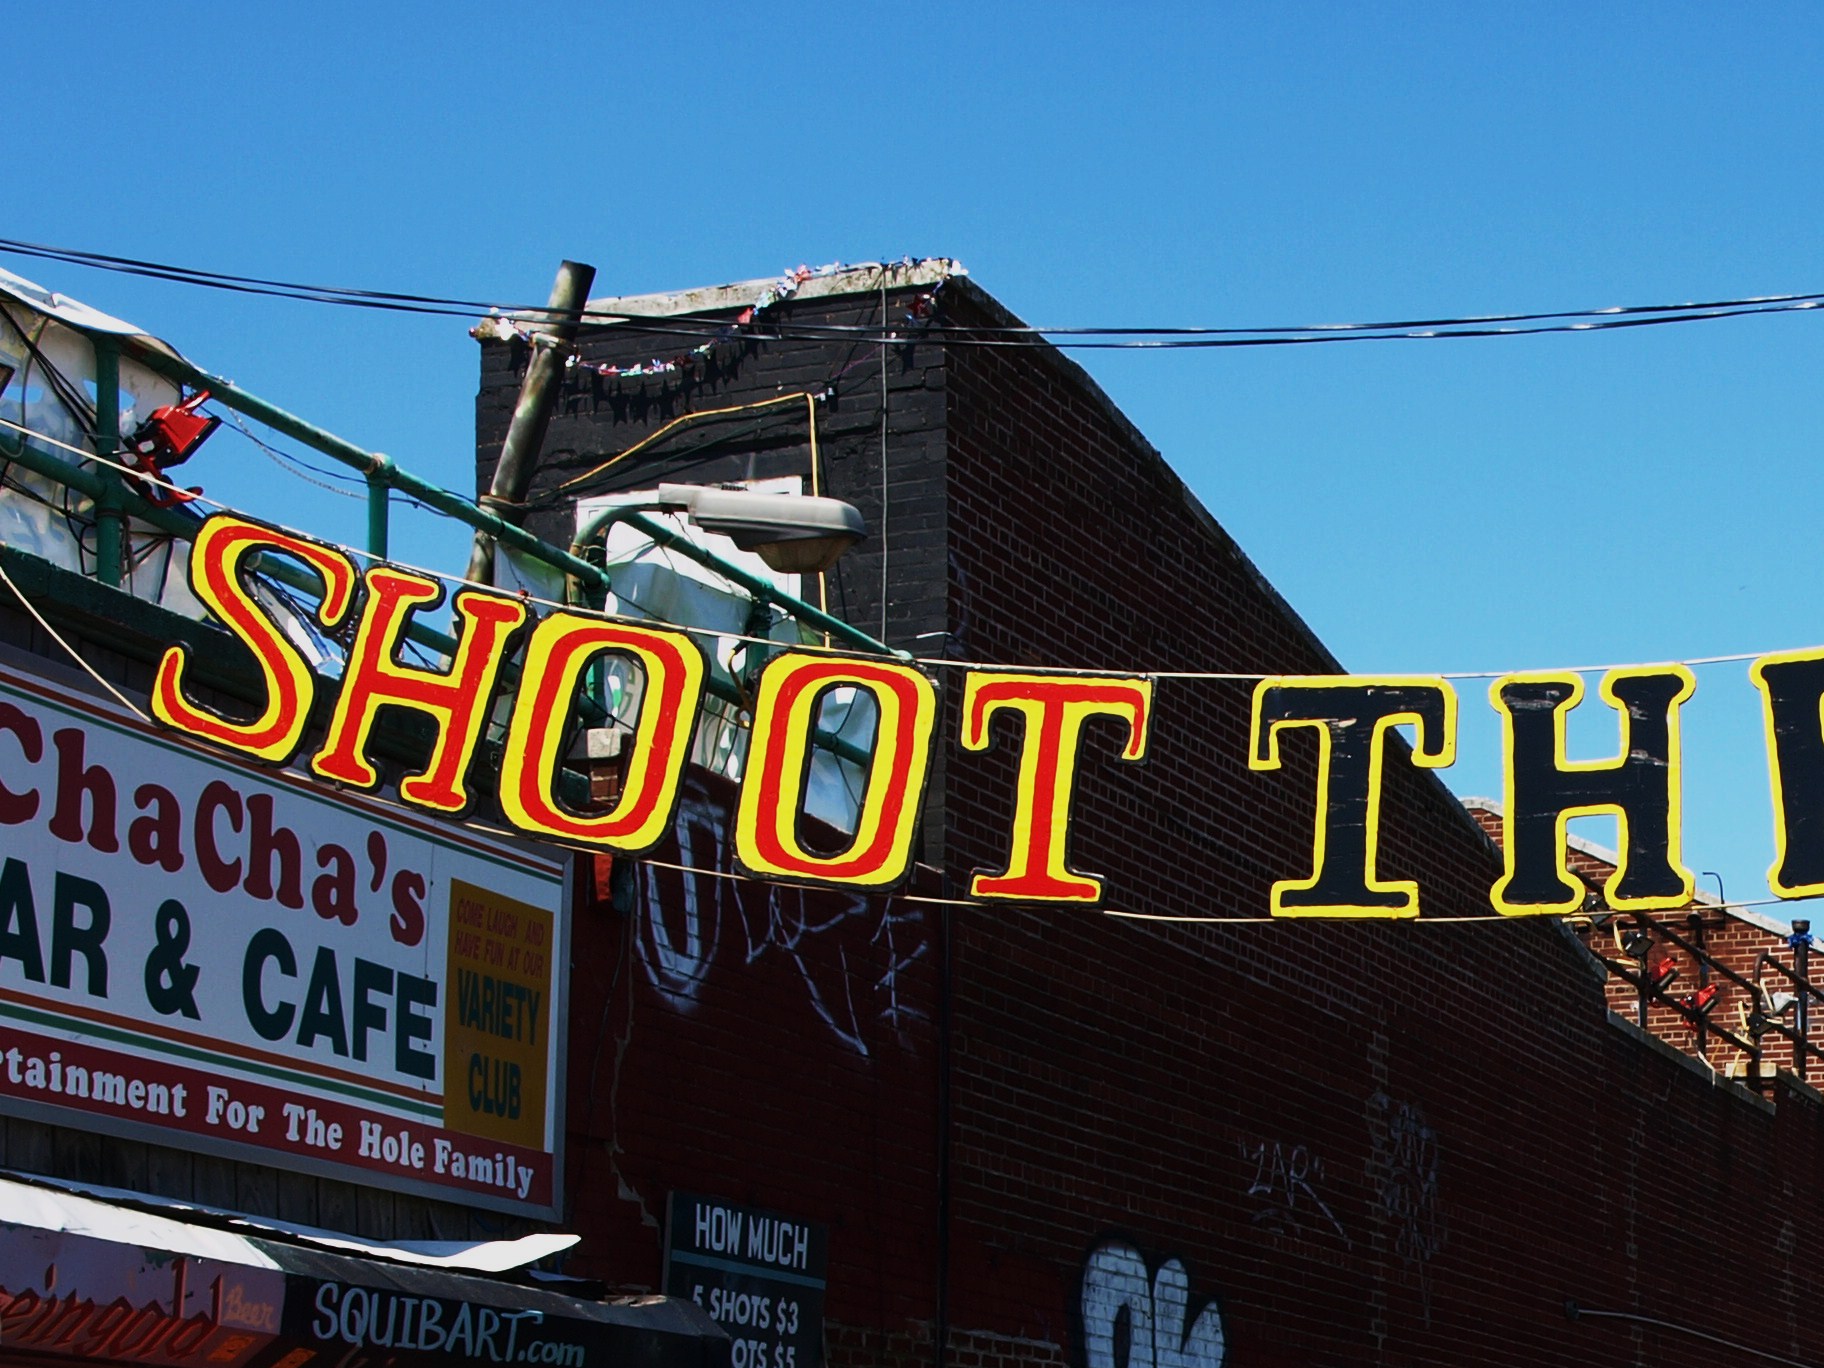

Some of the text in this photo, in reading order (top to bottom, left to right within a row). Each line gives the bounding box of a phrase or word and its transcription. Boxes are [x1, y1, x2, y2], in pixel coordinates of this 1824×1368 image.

[150, 512, 1158, 908] SHOOT
[0, 702, 427, 948] ChaCha's
[454, 929, 545, 979] HAVE FUN AT OUR
[456, 897, 545, 947] COME LAUGH AND
[0, 857, 439, 1081] AR & CAFE
[457, 966, 541, 1046] VARIETY
[0, 1046, 535, 1200] tainment For The Hole Family
[468, 1052, 522, 1121] CLUB
[694, 1202, 809, 1271] HOW MUCH
[0, 1256, 223, 1359] eingold
[311, 1281, 587, 1368] SQUIBART.com
[709, 1286, 771, 1330] SHOTS
[775, 1296, 799, 1336] $3
